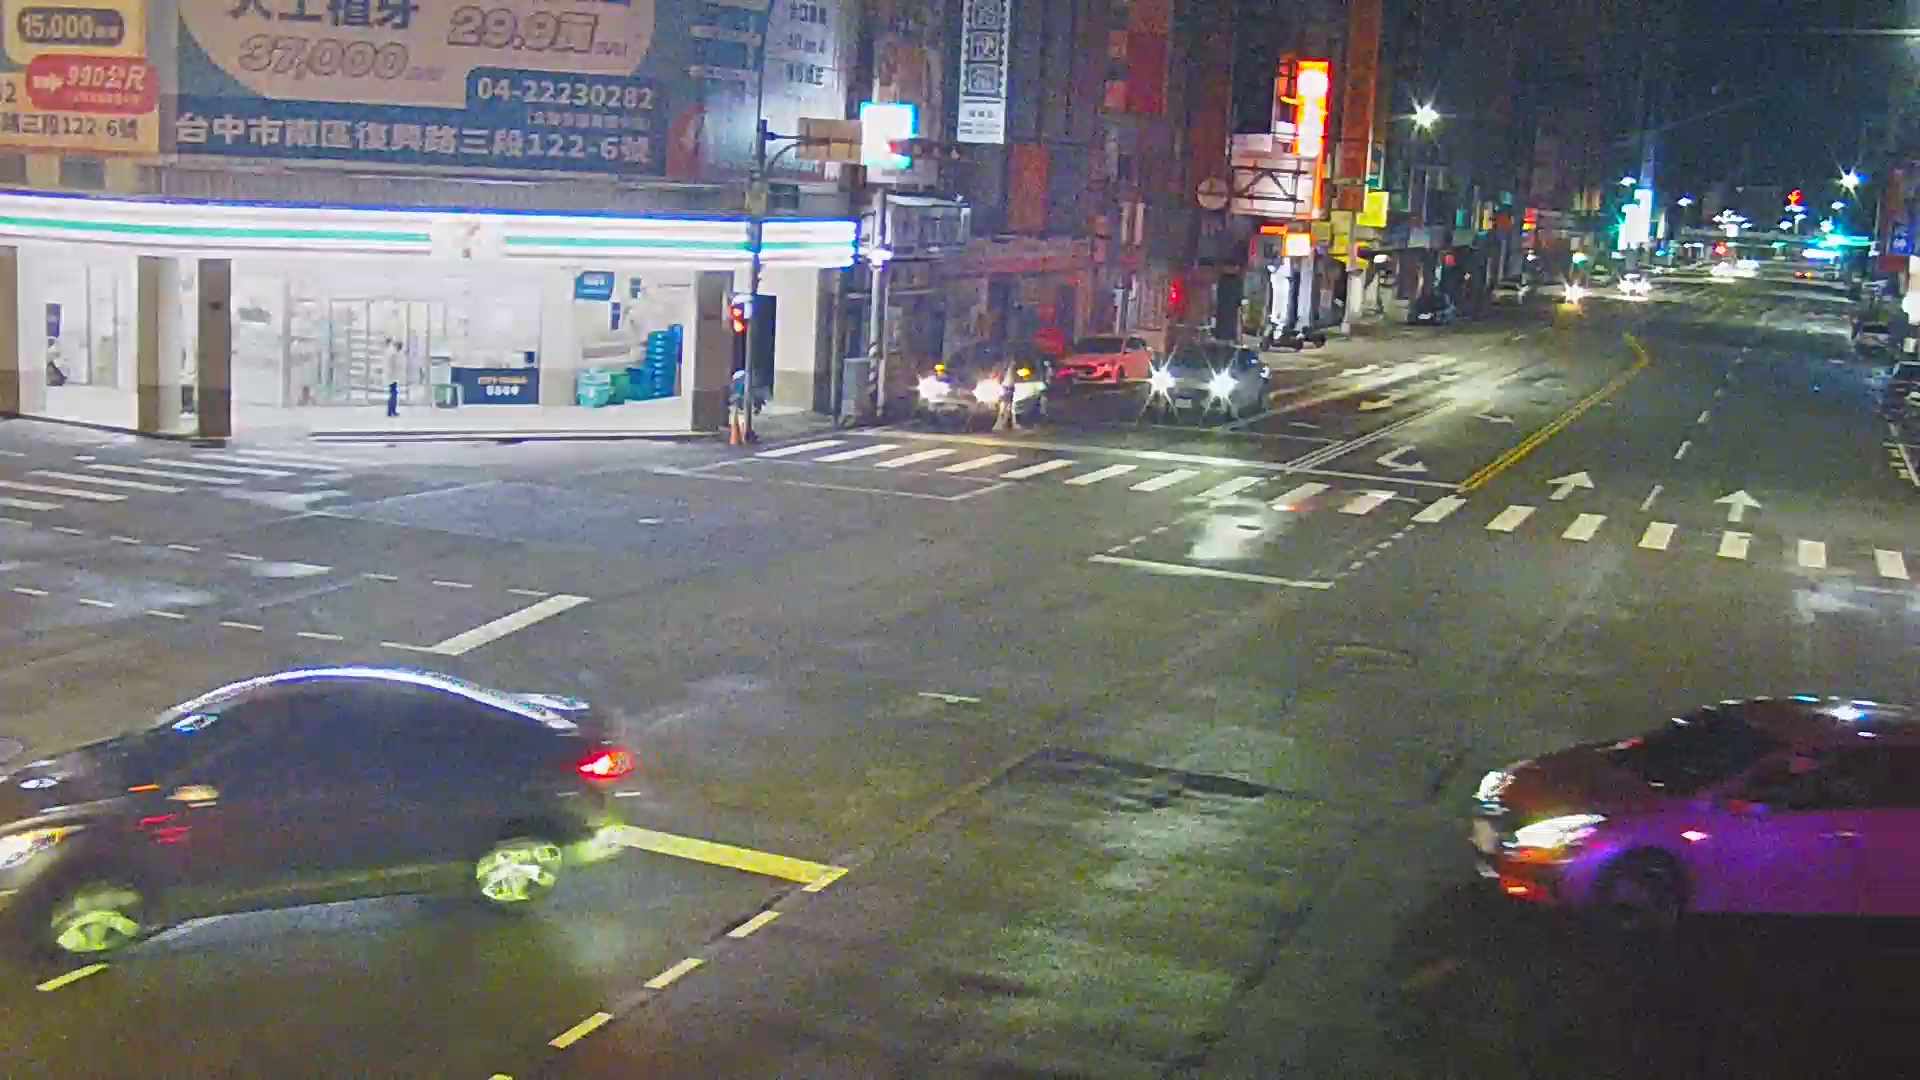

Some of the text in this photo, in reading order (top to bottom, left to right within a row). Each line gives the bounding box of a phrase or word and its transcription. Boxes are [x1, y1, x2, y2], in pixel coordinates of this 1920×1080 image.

[22, 13, 94, 38] 15,000
[239, 33, 410, 80] 37,000
[477, 76, 653, 110] 04-22230282
[176, 113, 650, 164] 台中市南區復興路三段122-6號
